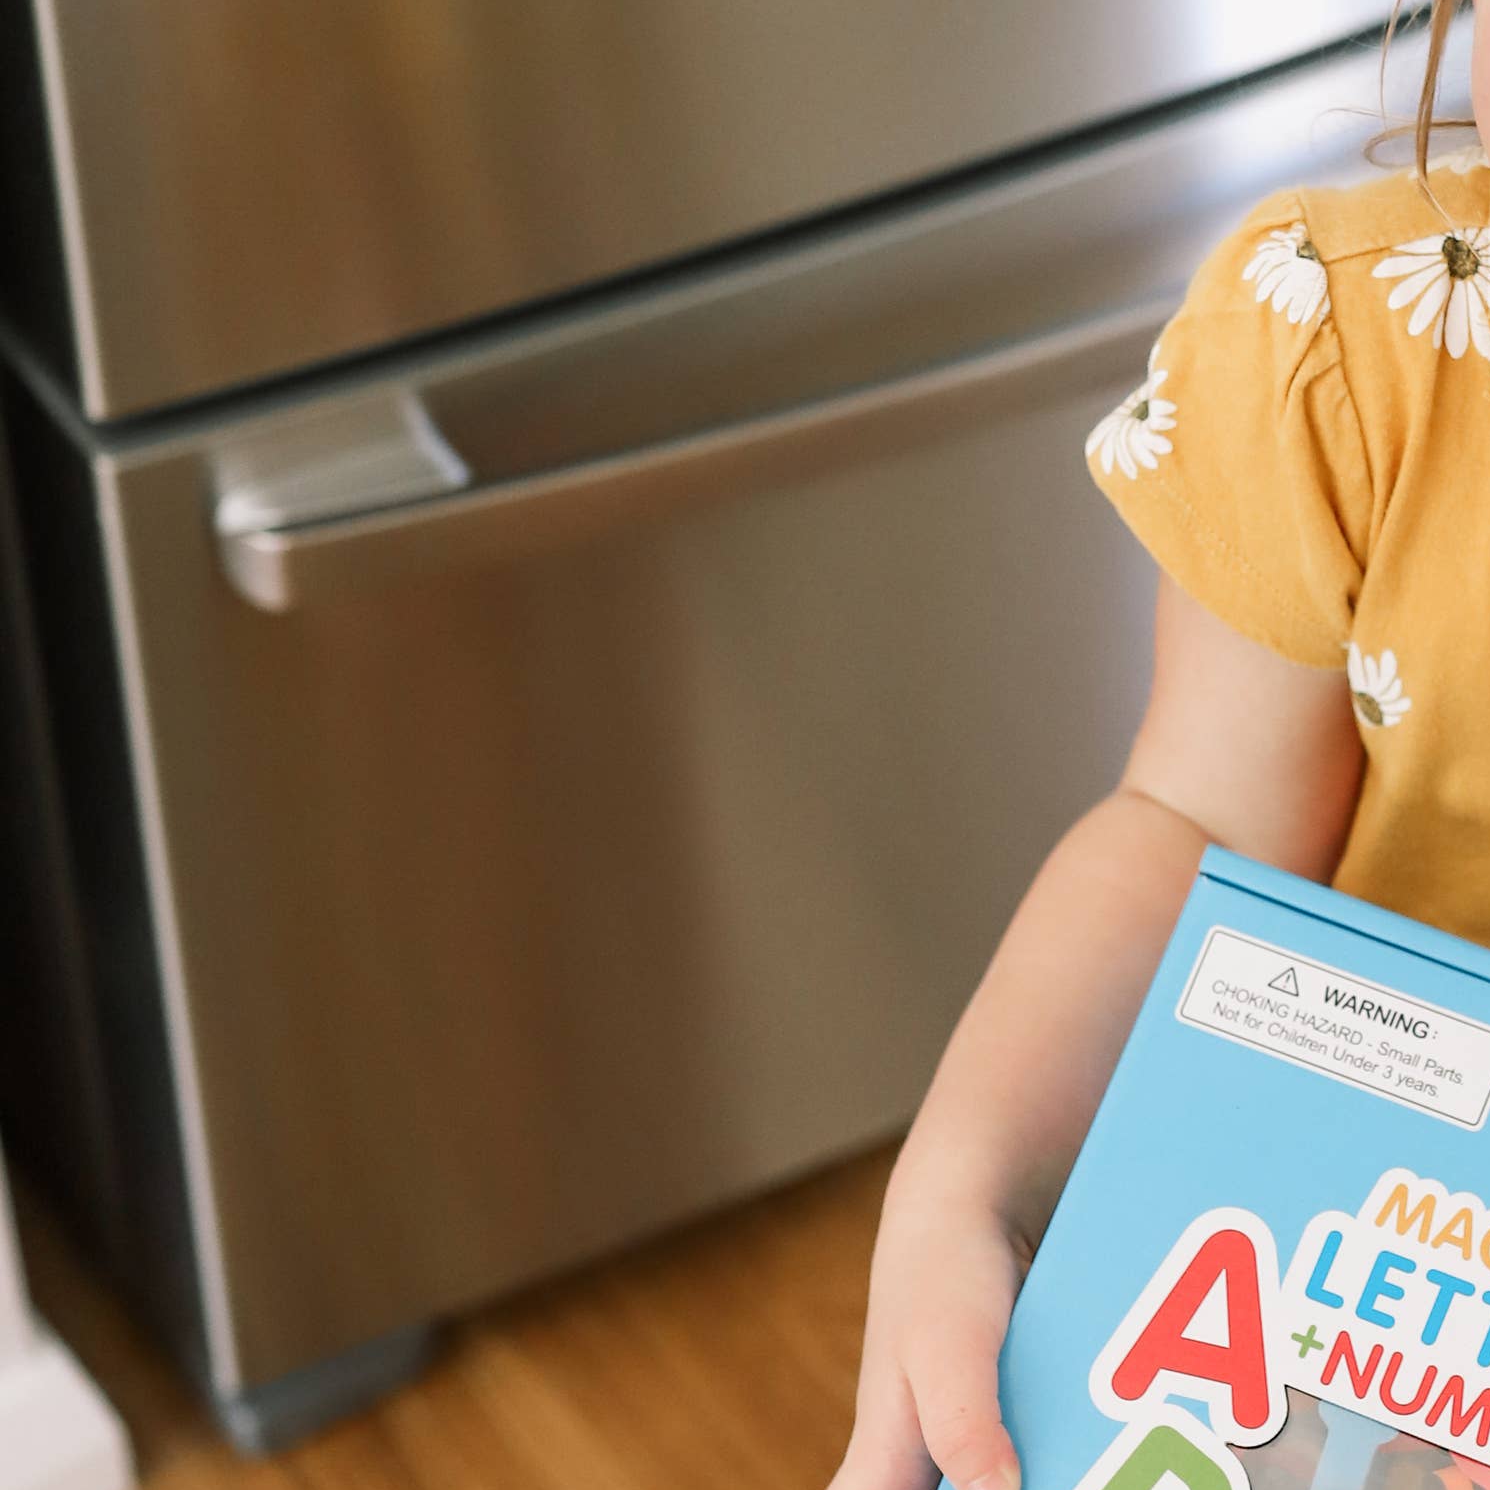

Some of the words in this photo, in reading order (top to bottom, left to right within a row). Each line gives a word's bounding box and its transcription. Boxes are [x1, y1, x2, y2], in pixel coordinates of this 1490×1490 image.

[1212, 979, 1290, 1018] CHOKING
[1293, 1010, 1363, 1046] HAZARD
[1377, 1041, 1421, 1067] Small
[1424, 1058, 1464, 1086] Parts.
[1213, 1001, 1240, 1022] Not
[1243, 1013, 1262, 1029] for
[1267, 1022, 1328, 1055] Children
[1333, 1046, 1379, 1073] Under
[1382, 1064, 1393, 1080] 3
[1396, 1073, 1439, 1099] years.
[1111, 1229, 1270, 1430] A
